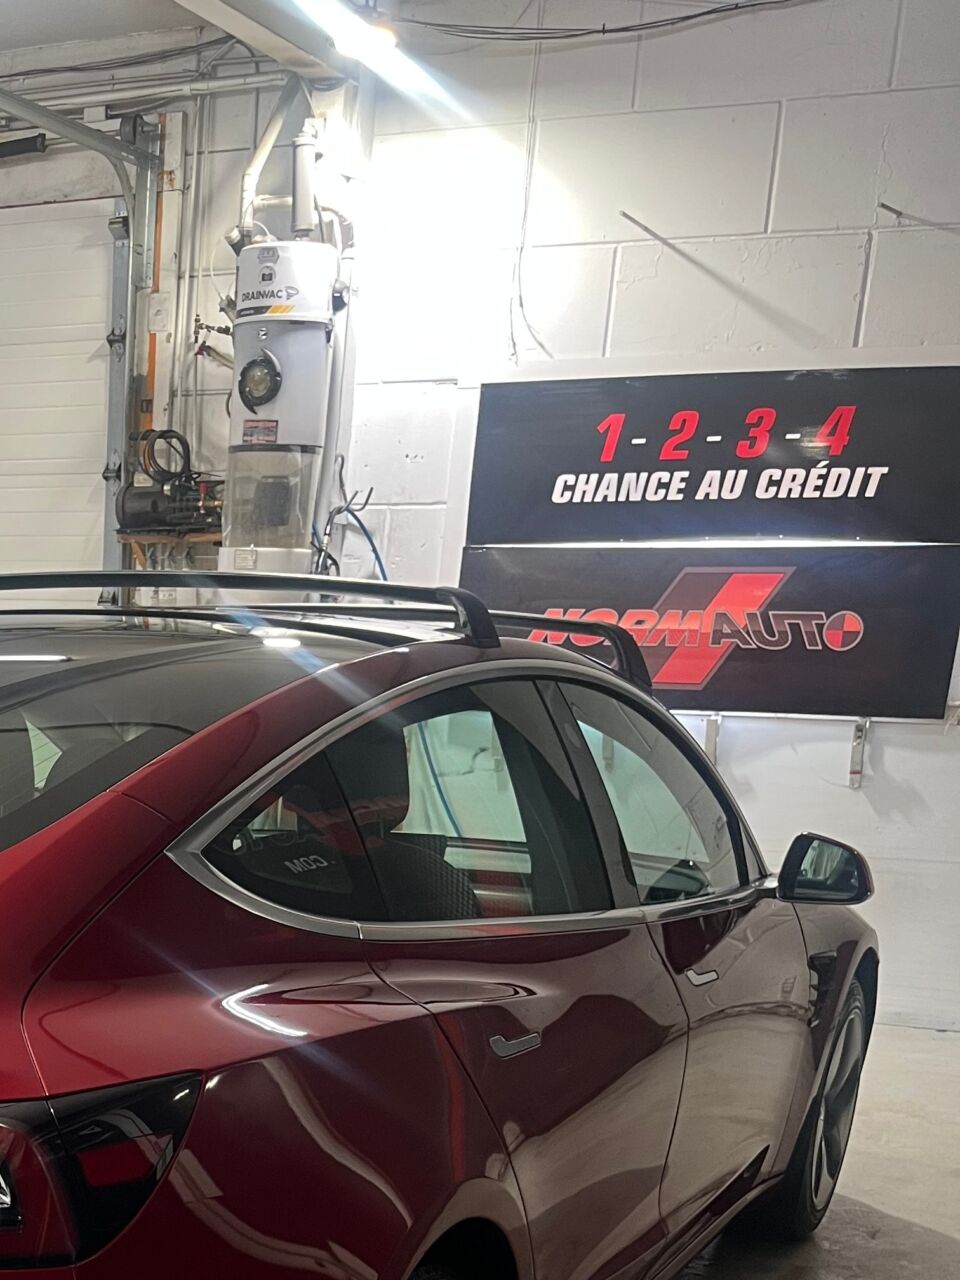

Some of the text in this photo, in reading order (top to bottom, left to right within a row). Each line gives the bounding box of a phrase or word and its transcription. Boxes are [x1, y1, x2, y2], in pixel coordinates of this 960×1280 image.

[242, 290, 283, 302] DRAINVAC
[551, 459, 889, 504] CHANCE AU CRÉDIT
